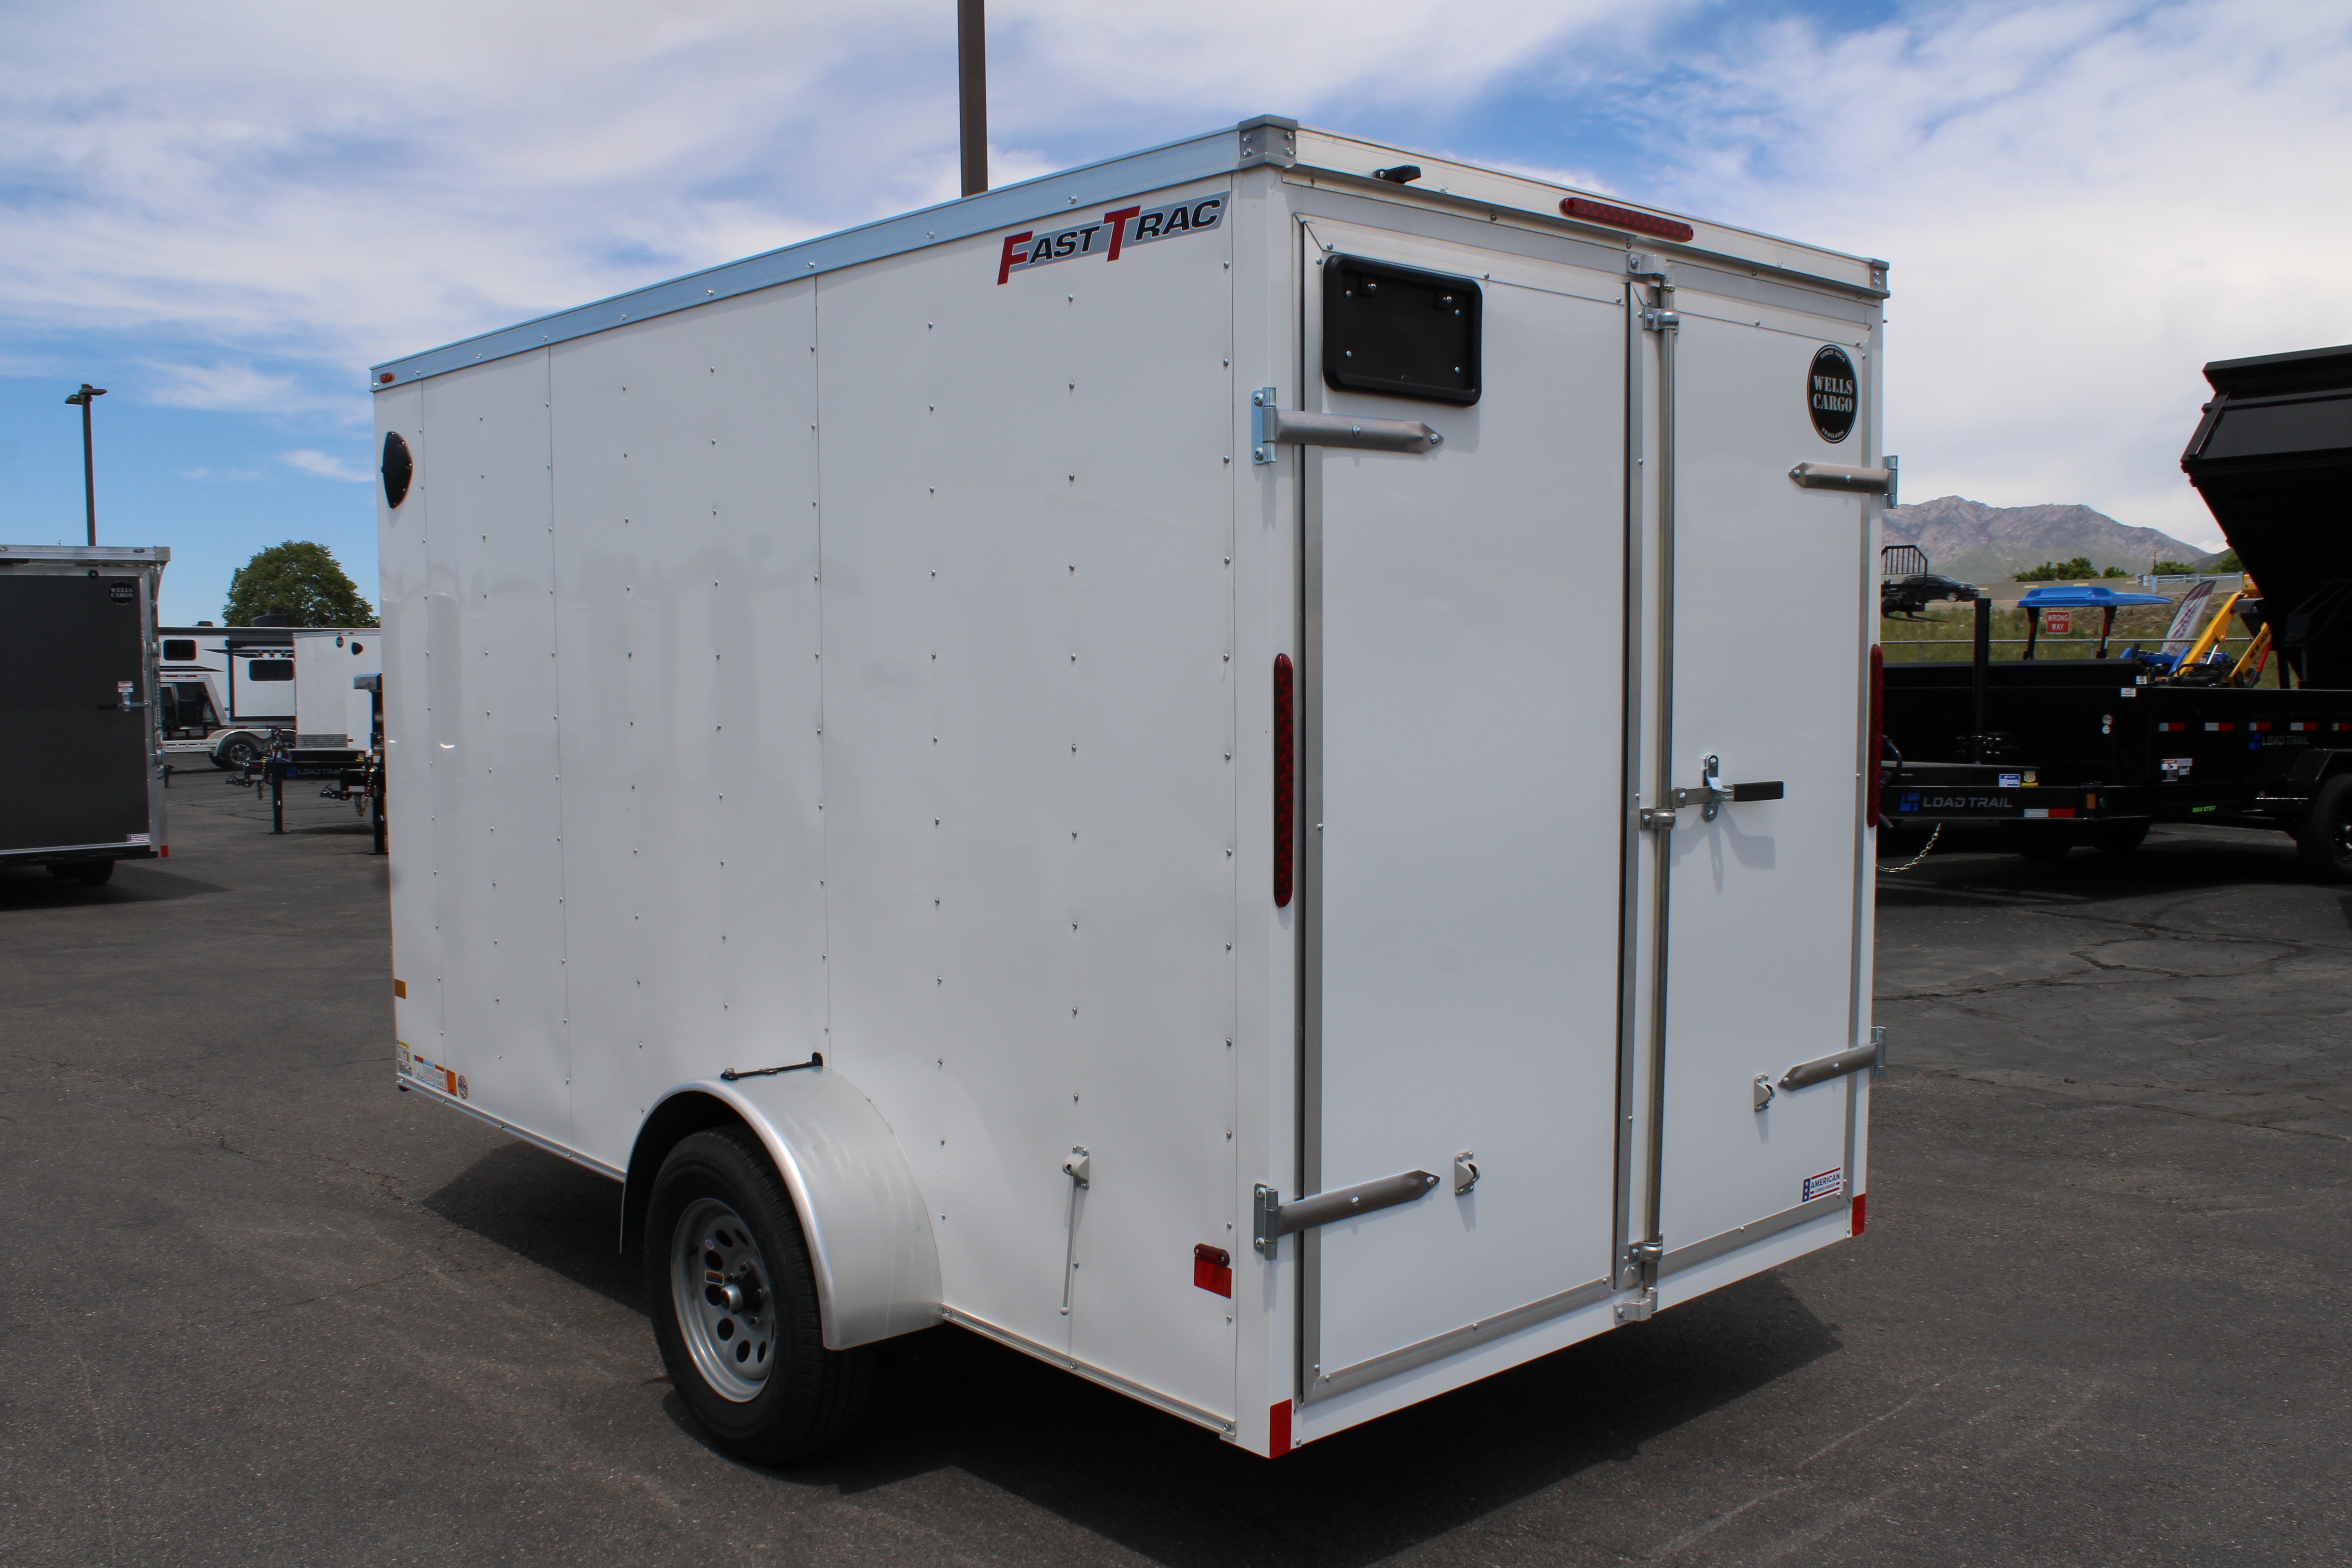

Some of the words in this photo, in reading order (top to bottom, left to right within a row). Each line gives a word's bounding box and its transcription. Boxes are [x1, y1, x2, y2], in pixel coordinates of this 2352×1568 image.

[997, 225, 1101, 285] FAST
[1103, 199, 1221, 262] TRAC
[1820, 350, 1833, 359] SINCE
[1813, 375, 1853, 395] WELLS
[1813, 393, 1853, 412] CARGO
[1822, 427, 1844, 438] TRAILERS
[2261, 735, 2284, 746] LOAD
[2286, 735, 2310, 745] TRAIL
[1923, 797, 1966, 807] LOAD
[1968, 797, 2012, 808] TRAIL
[1810, 1173, 1840, 1189] AMERICAN
